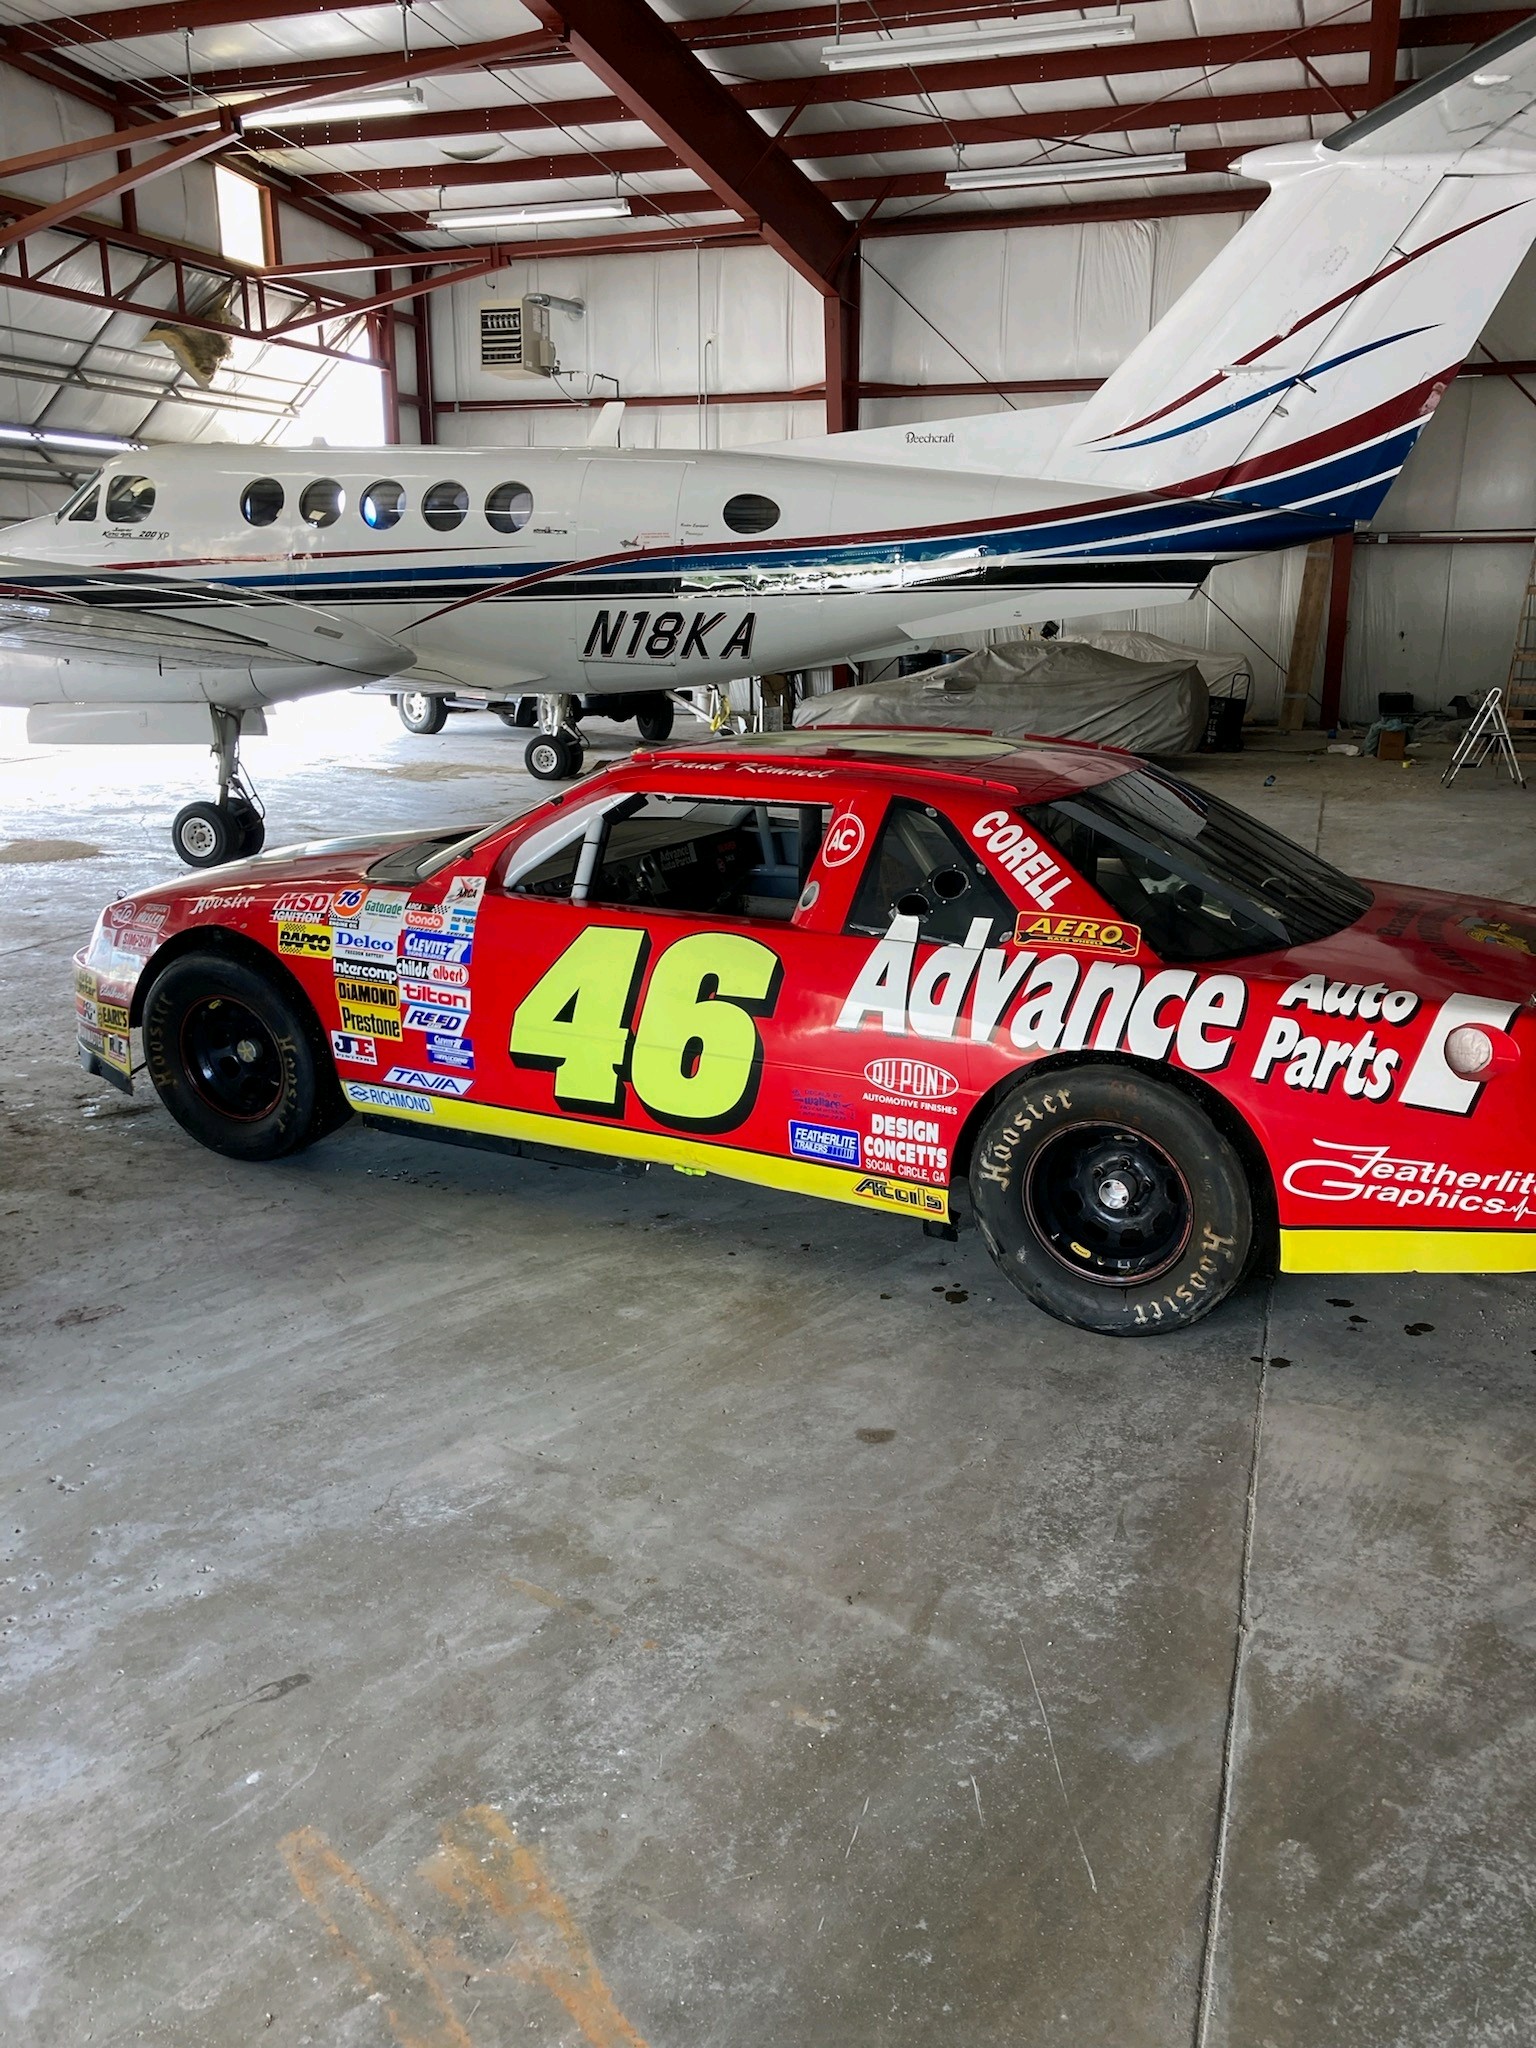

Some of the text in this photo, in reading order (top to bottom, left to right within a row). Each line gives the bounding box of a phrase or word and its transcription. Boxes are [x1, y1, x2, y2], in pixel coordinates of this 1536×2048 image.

[905, 431, 954, 443] Beechcraft
[139, 530, 157, 538] 200
[157, 531, 169, 540] XP
[583, 610, 756, 659] N18KA
[652, 759, 834, 778] Frank Kimmel
[828, 829, 856, 851] AC
[972, 810, 1072, 911] CORELL
[189, 893, 255, 914] Hoosier
[276, 893, 329, 911] MSD
[335, 889, 362, 907] 76
[365, 900, 402, 915] Gatorade
[272, 910, 321, 924] IGNITION
[408, 912, 441, 926] bondo
[123, 932, 154, 948] SIMPSON
[336, 932, 394, 951] Delco
[1027, 917, 1123, 944] AERO
[1072, 938, 1104, 946] WHEELS
[405, 933, 447, 956] CLEVITE
[333, 958, 398, 984] Intercomp
[397, 959, 428, 978] childs
[433, 966, 464, 982] albert
[403, 984, 467, 1008] tilton
[836, 914, 1249, 1073] Advance
[1277, 973, 1421, 1028] Auto
[342, 1007, 400, 1038] Prestone
[408, 1010, 461, 1031] REED
[509, 924, 785, 1135] 46
[335, 1035, 375, 1058] JE
[1251, 1016, 1402, 1101] Parts
[394, 1070, 461, 1093] TAVIA
[370, 1089, 430, 1112] RICHMOND
[862, 1092, 958, 1115] AUTOMOTIVE FINISHES
[795, 1128, 857, 1149] FEATHERLITE
[872, 1113, 940, 1144] DESIGN
[979, 1087, 1073, 1192] Hoosier
[795, 1139, 828, 1154] TRAILERS
[866, 1158, 946, 1183] SOCIAL CIRCLE, GA
[1282, 1159, 1506, 1214] Graphics
